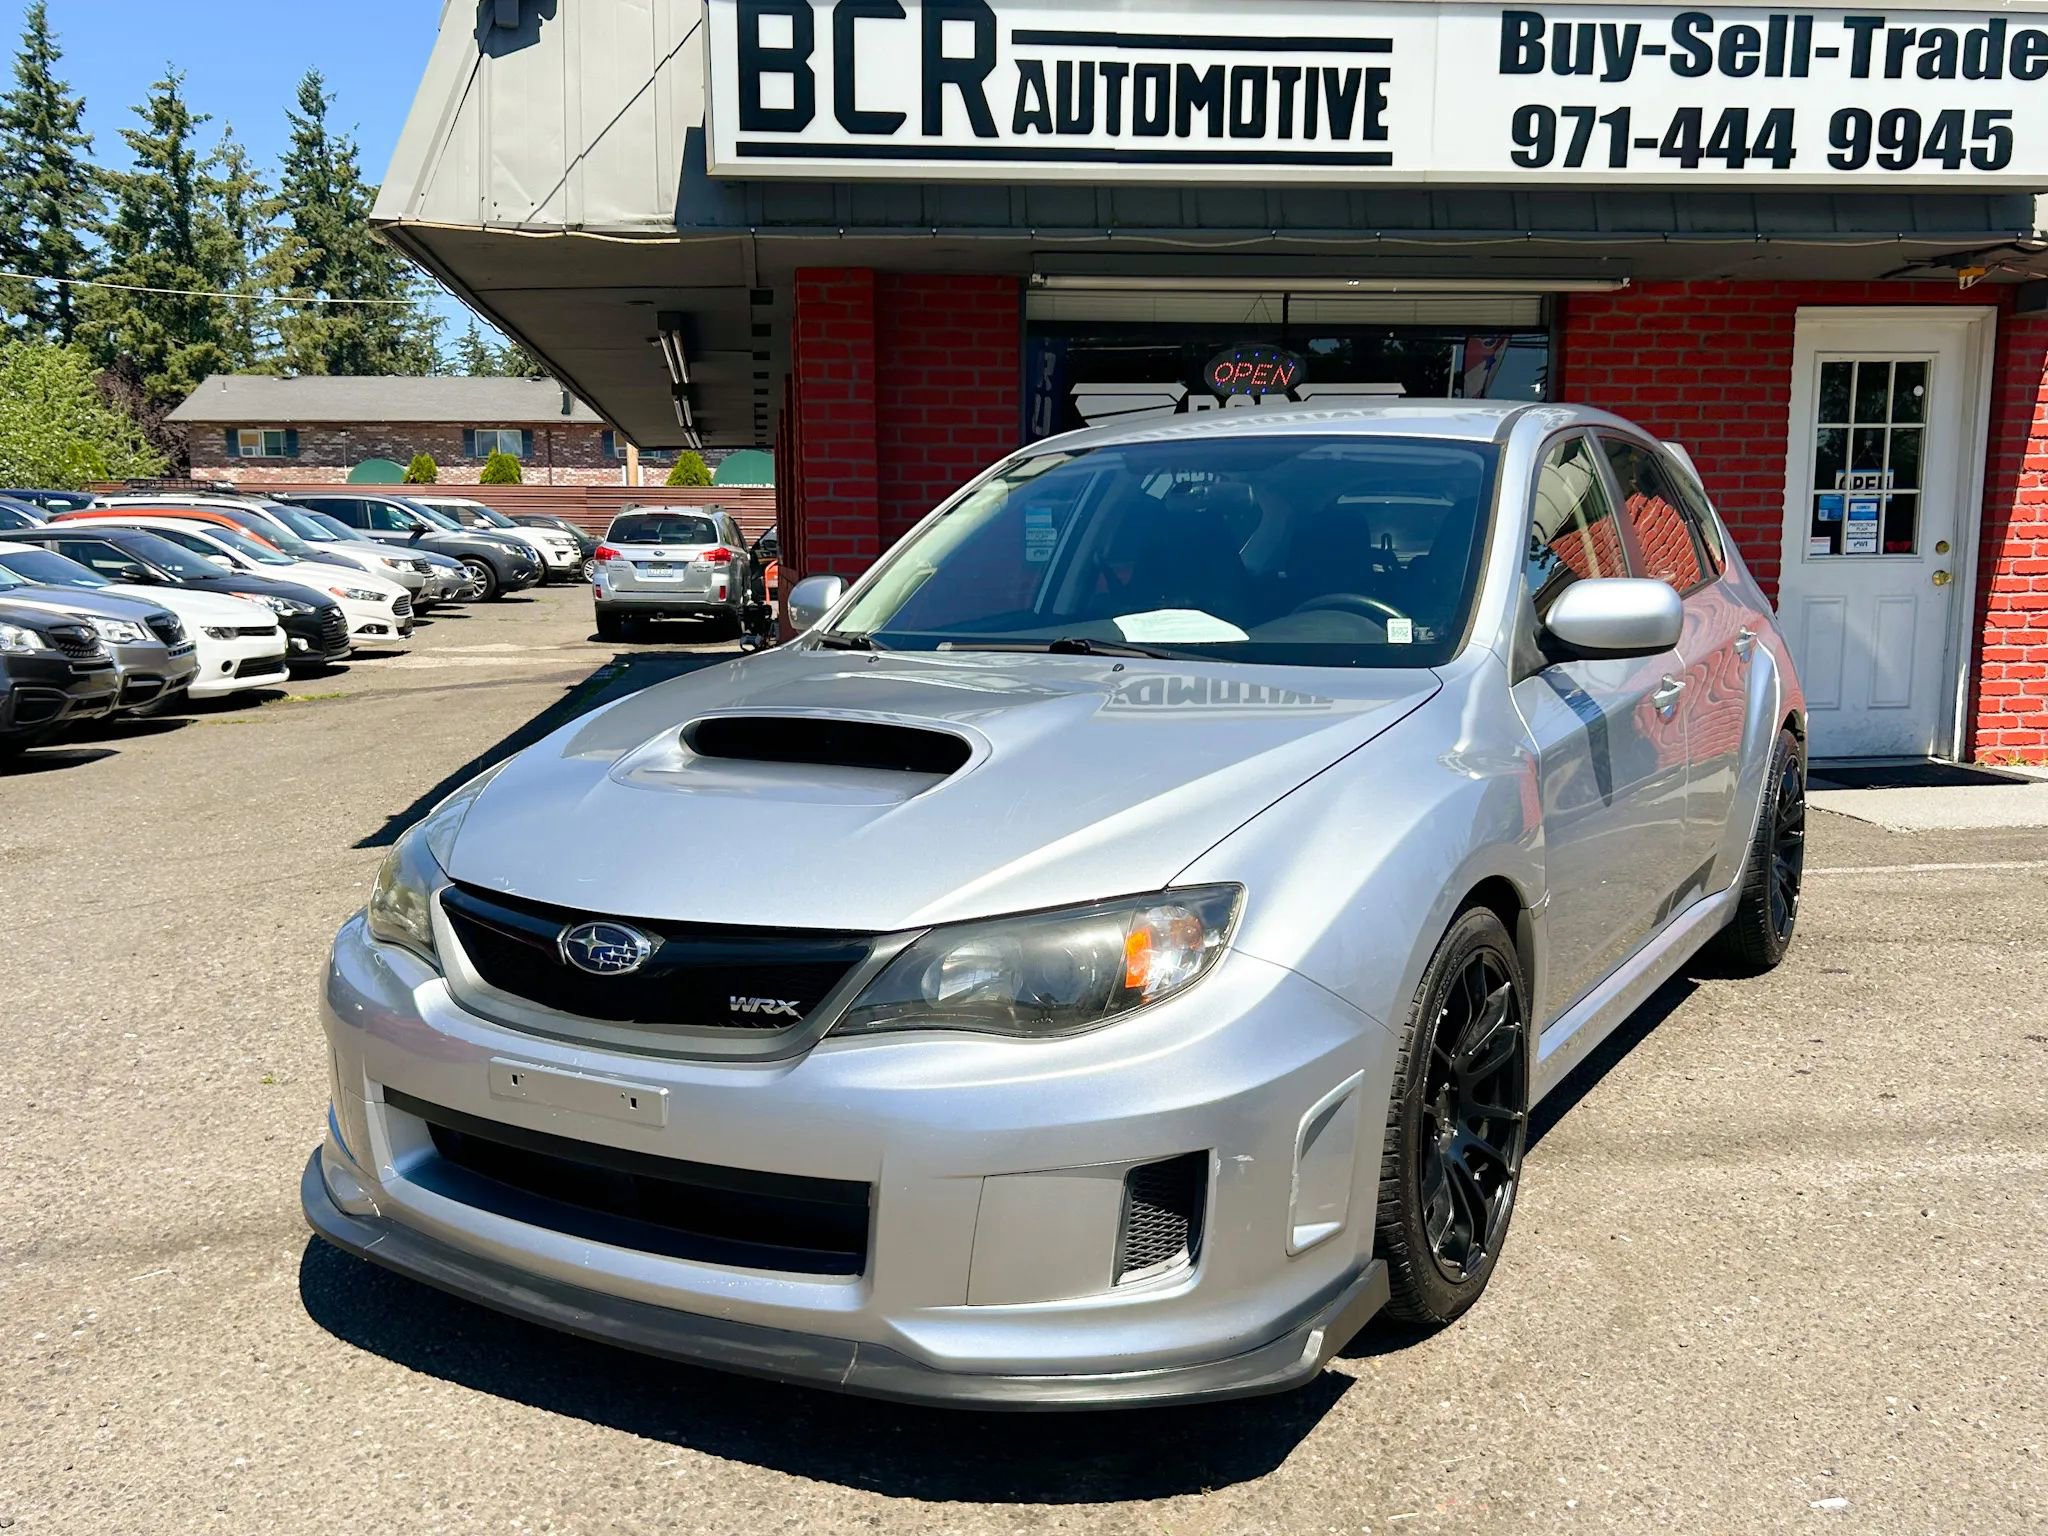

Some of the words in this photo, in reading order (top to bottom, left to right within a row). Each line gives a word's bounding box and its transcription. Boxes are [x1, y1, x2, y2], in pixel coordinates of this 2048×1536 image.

[1499, 10, 2048, 82] Buy-Sell-Trade
[738, 0, 1000, 137] BCR
[1012, 58, 1391, 141] AUTOMOTIVE
[1510, 104, 1797, 169] 971-444
[1826, 107, 2014, 171] 9945
[1214, 361, 1295, 386] OPEN
[1838, 474, 1890, 496] OPEN
[729, 995, 801, 1016] WRX
